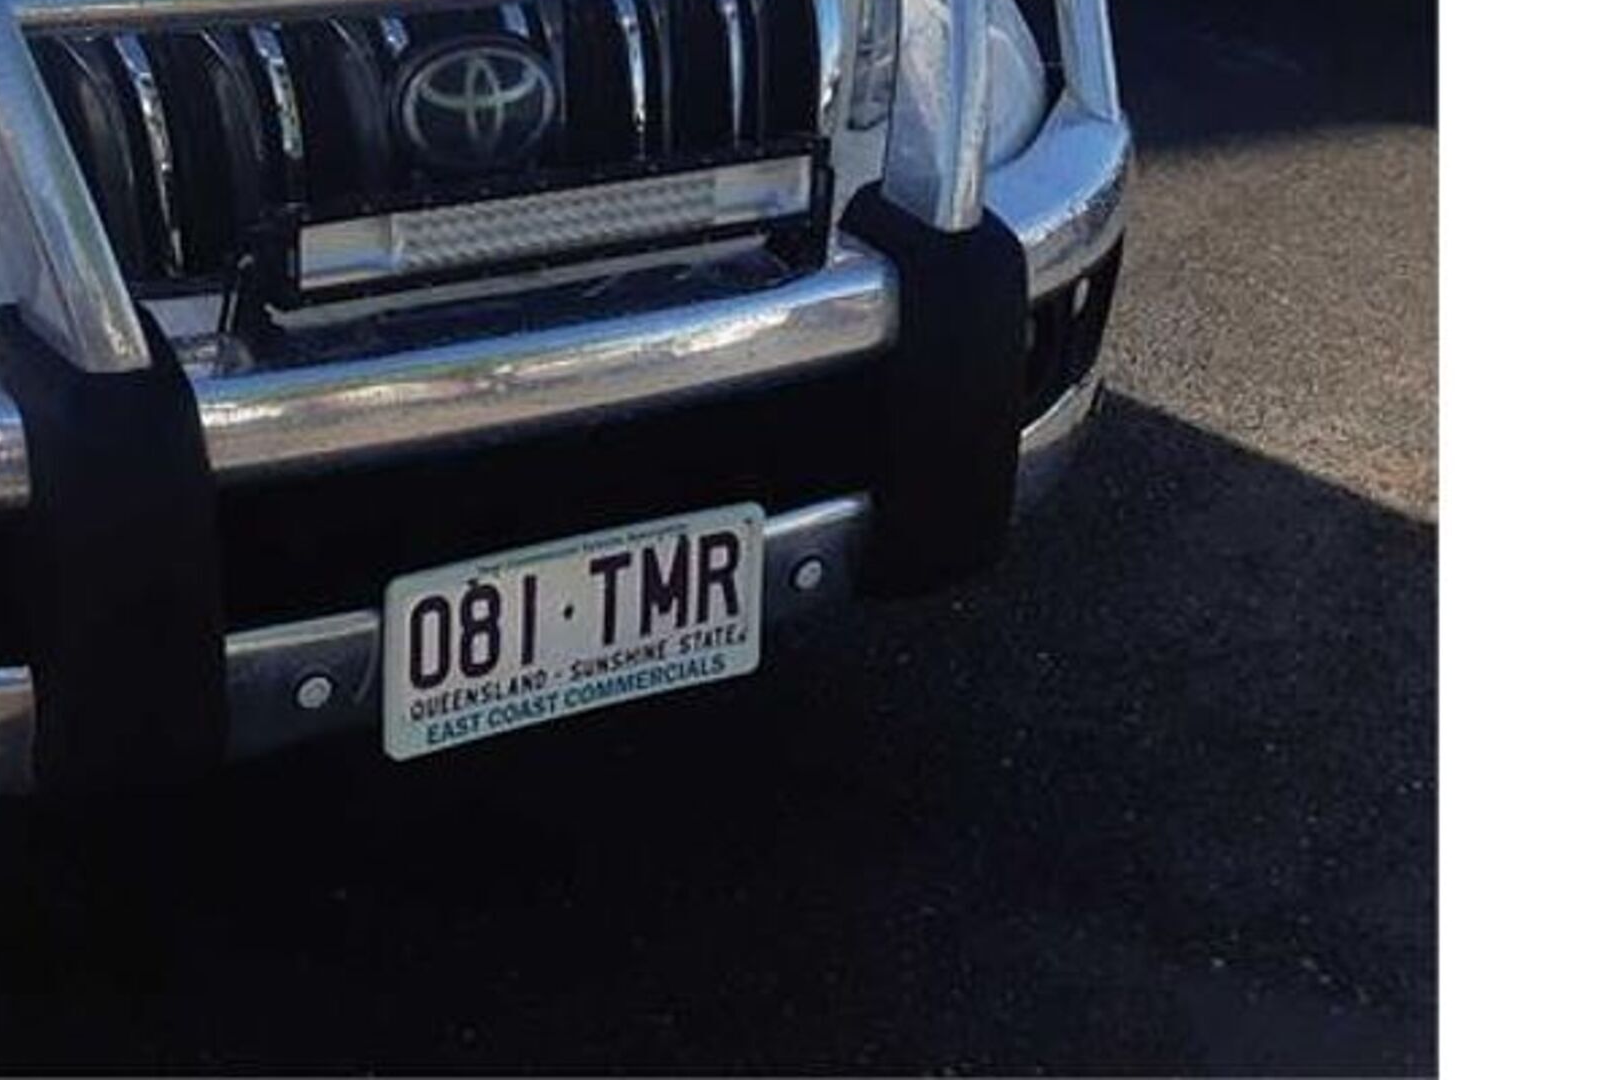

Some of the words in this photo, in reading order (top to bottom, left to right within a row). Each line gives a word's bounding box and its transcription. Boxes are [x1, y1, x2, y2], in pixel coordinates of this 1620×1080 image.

[589, 531, 740, 645] TMR
[410, 667, 548, 720] QUEENSLAND
[571, 638, 667, 680] SUNSHINE
[428, 712, 487, 745] EAST
[486, 693, 559, 728] COAST
[564, 653, 727, 708] COMMERCIALS
